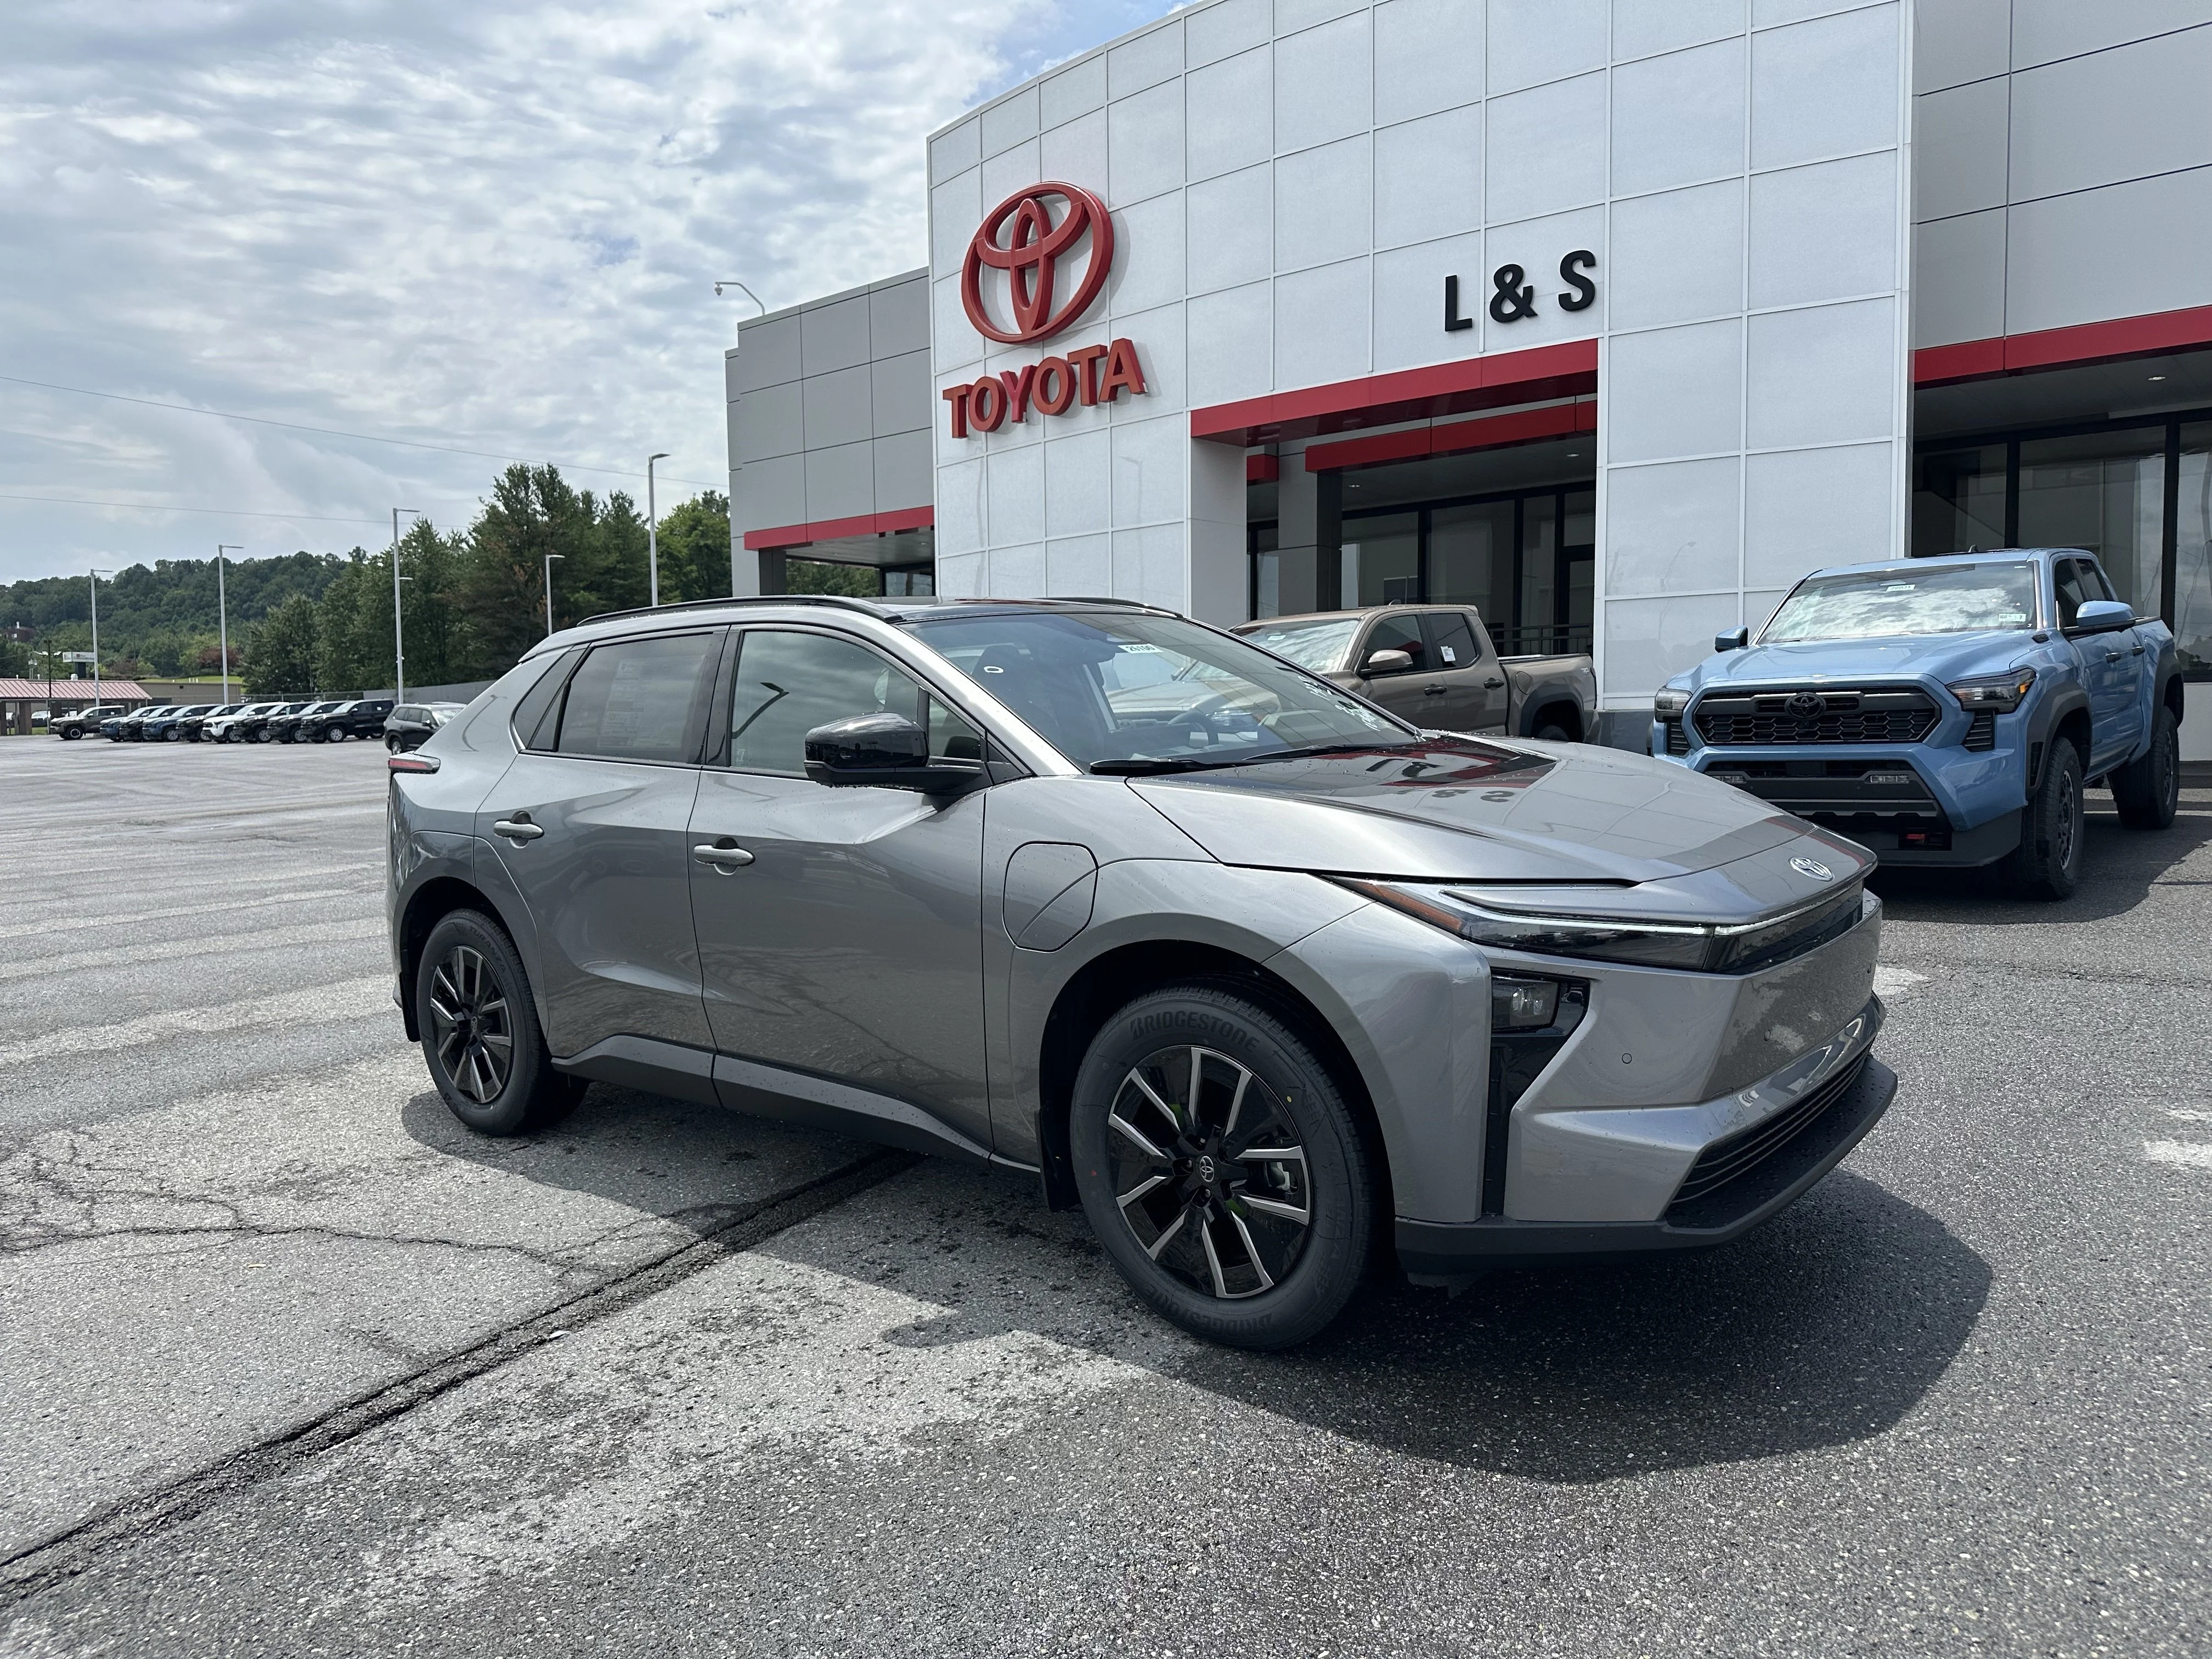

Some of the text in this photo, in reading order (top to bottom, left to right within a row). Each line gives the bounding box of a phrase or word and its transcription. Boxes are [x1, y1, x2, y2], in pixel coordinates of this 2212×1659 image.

[1445, 250, 1596, 332] L & S
[943, 338, 1148, 439] TOYOTA
[469, 926, 506, 973] TURANZA
[1130, 1011, 1260, 1053] BRIDGESTONE
